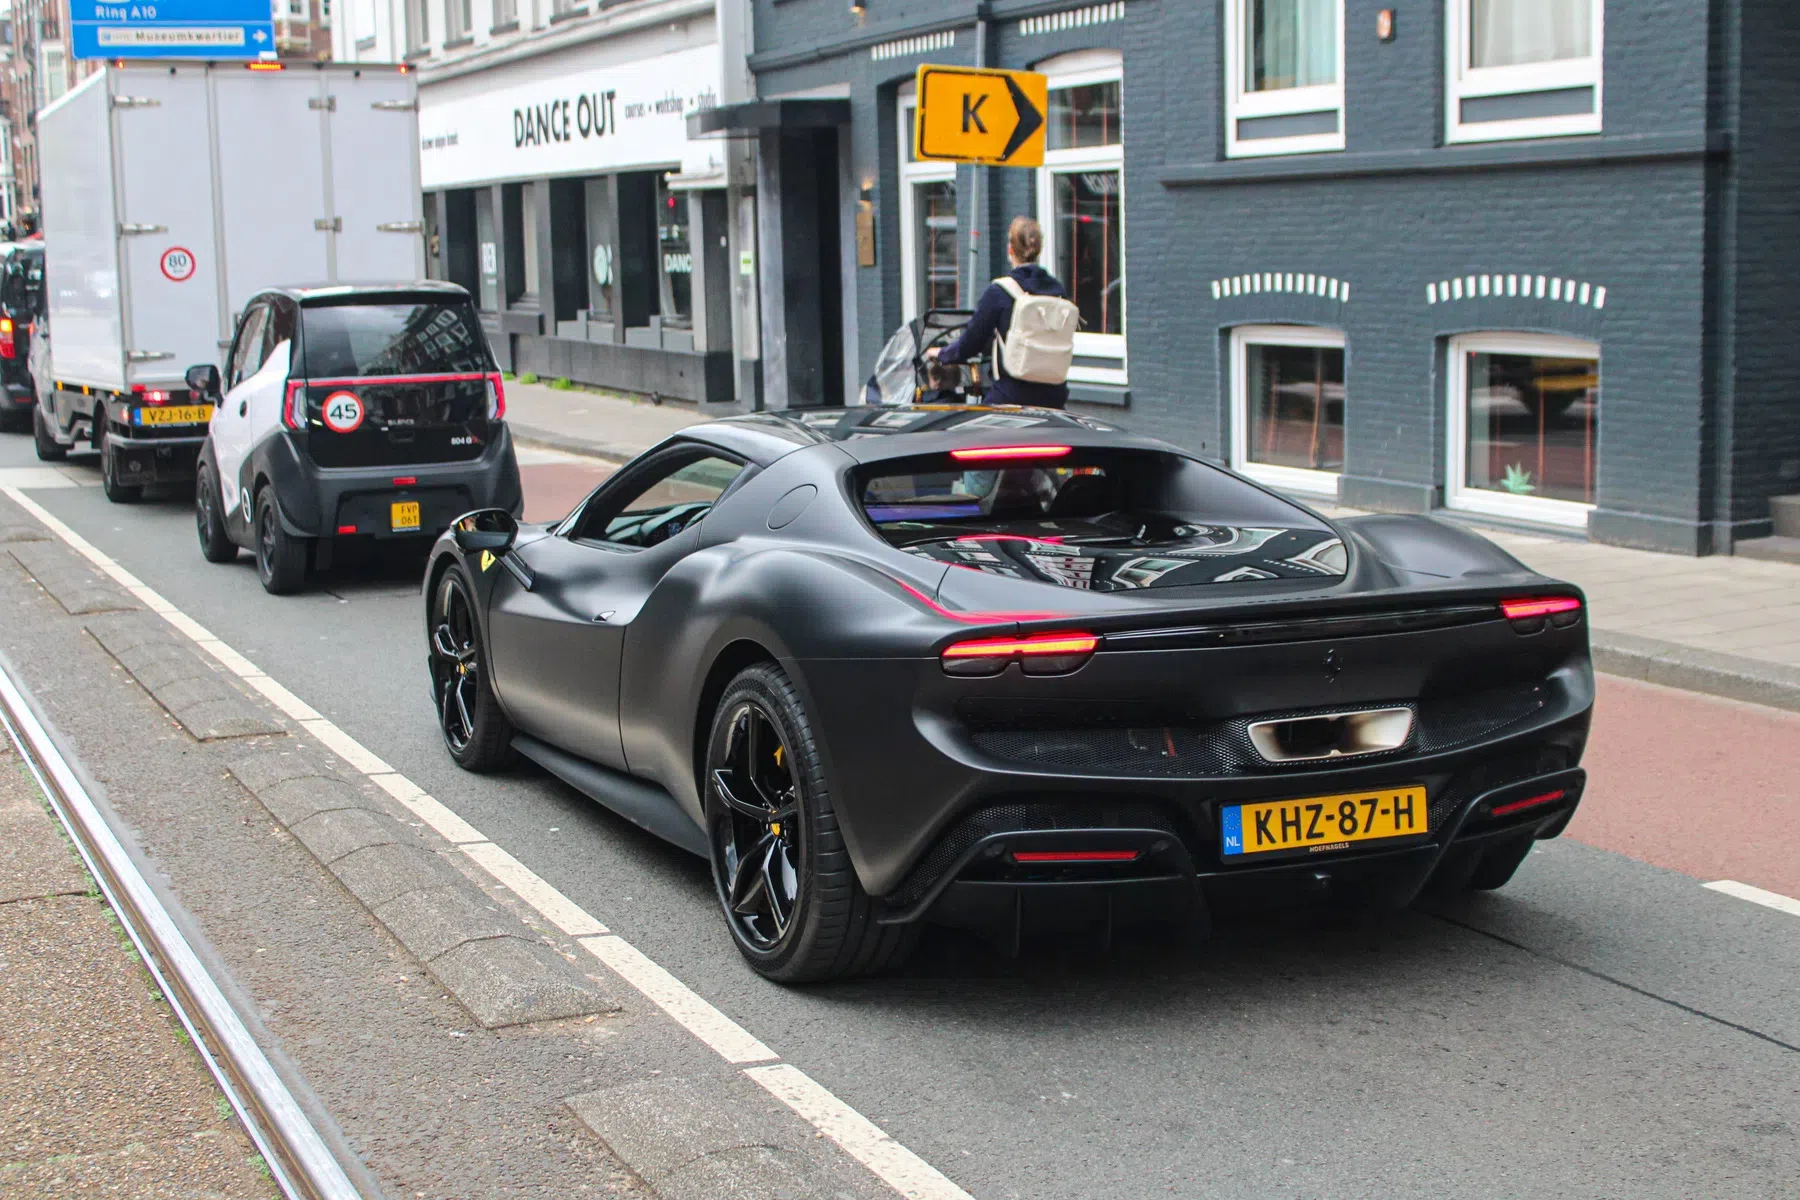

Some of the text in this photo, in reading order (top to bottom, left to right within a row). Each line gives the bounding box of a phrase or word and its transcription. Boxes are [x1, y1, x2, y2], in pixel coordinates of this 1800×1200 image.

[95, 5, 157, 21] Ring A10
[135, 30, 240, 42] Museumkwartier
[514, 99, 571, 148] DANCE
[577, 89, 616, 139] OUT
[962, 93, 988, 133] K
[169, 253, 187, 268] 80
[149, 407, 206, 421] VZJ-16-B
[330, 403, 357, 420] 45
[1254, 794, 1415, 846] KHZ-87-H
[1225, 836, 1241, 848] NL
[1309, 842, 1350, 853] HOEFNAGELS
